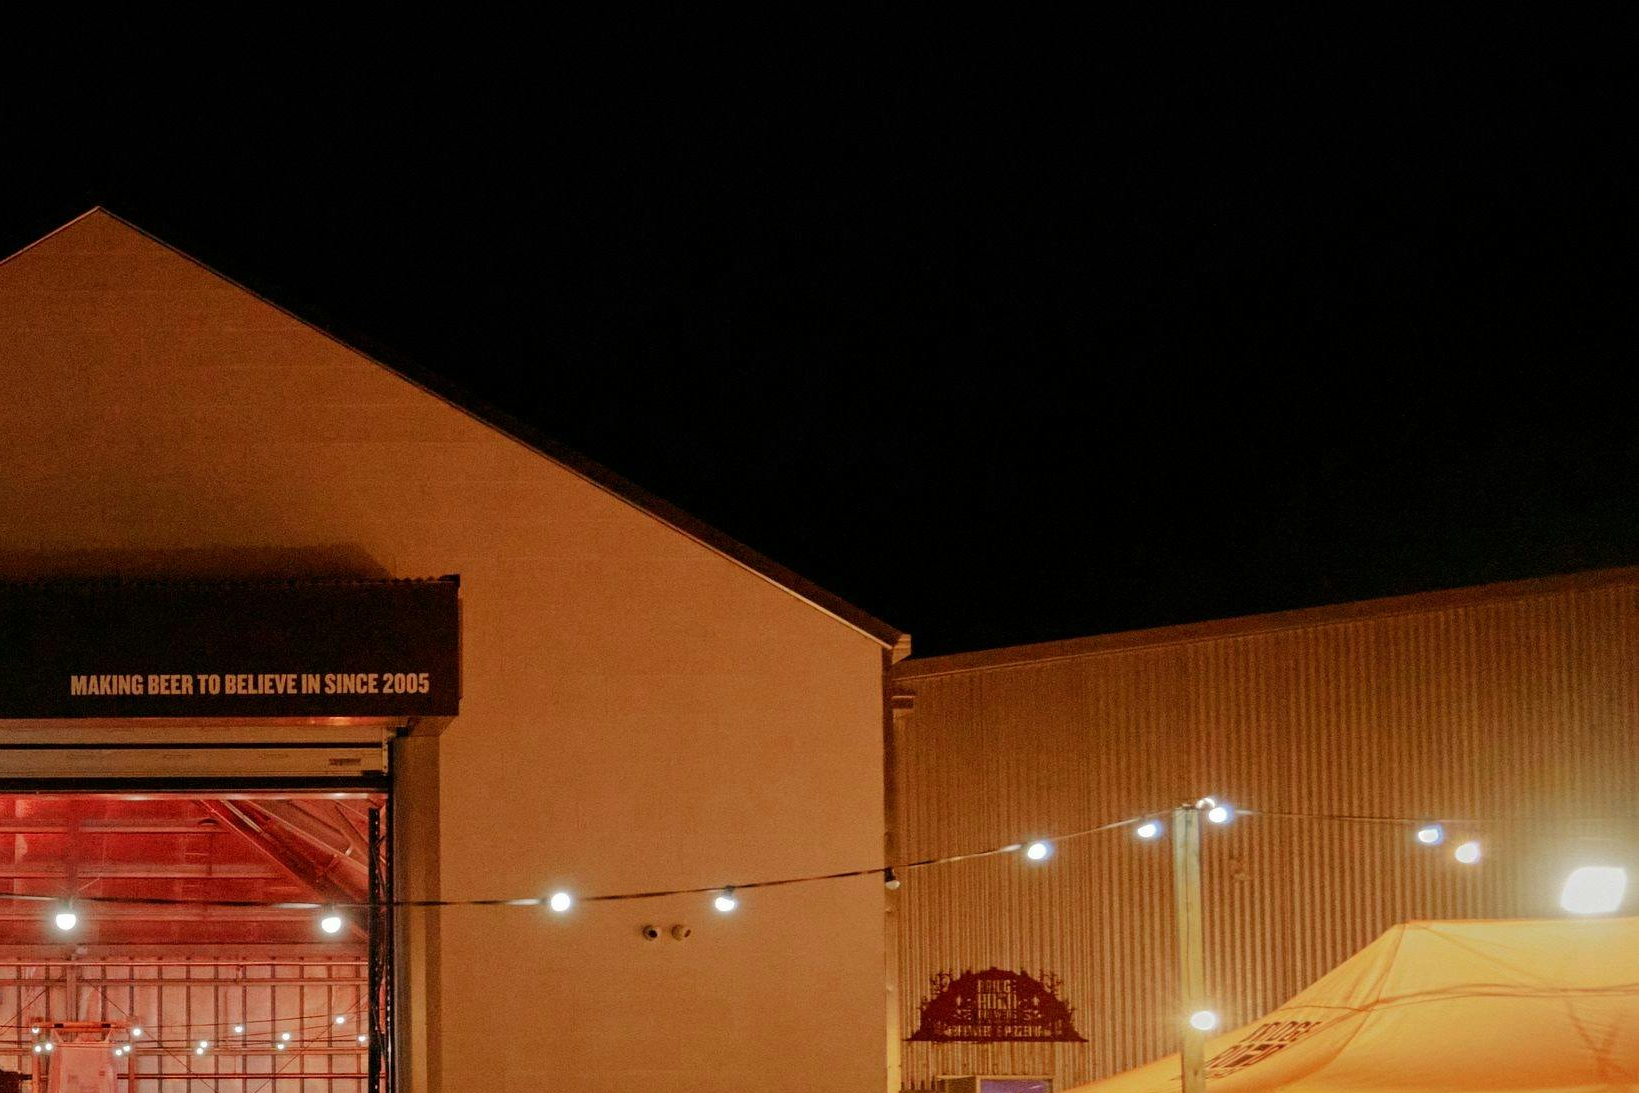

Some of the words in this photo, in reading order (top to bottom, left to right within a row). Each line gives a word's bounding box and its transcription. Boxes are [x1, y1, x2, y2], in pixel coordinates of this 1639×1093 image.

[71, 674, 143, 696] MAKING
[148, 674, 194, 696] BEER
[198, 674, 221, 695] TO
[225, 673, 297, 695] BELIEVE
[302, 673, 320, 694] IN
[325, 673, 379, 694] SINCE
[383, 672, 430, 694] 2005
